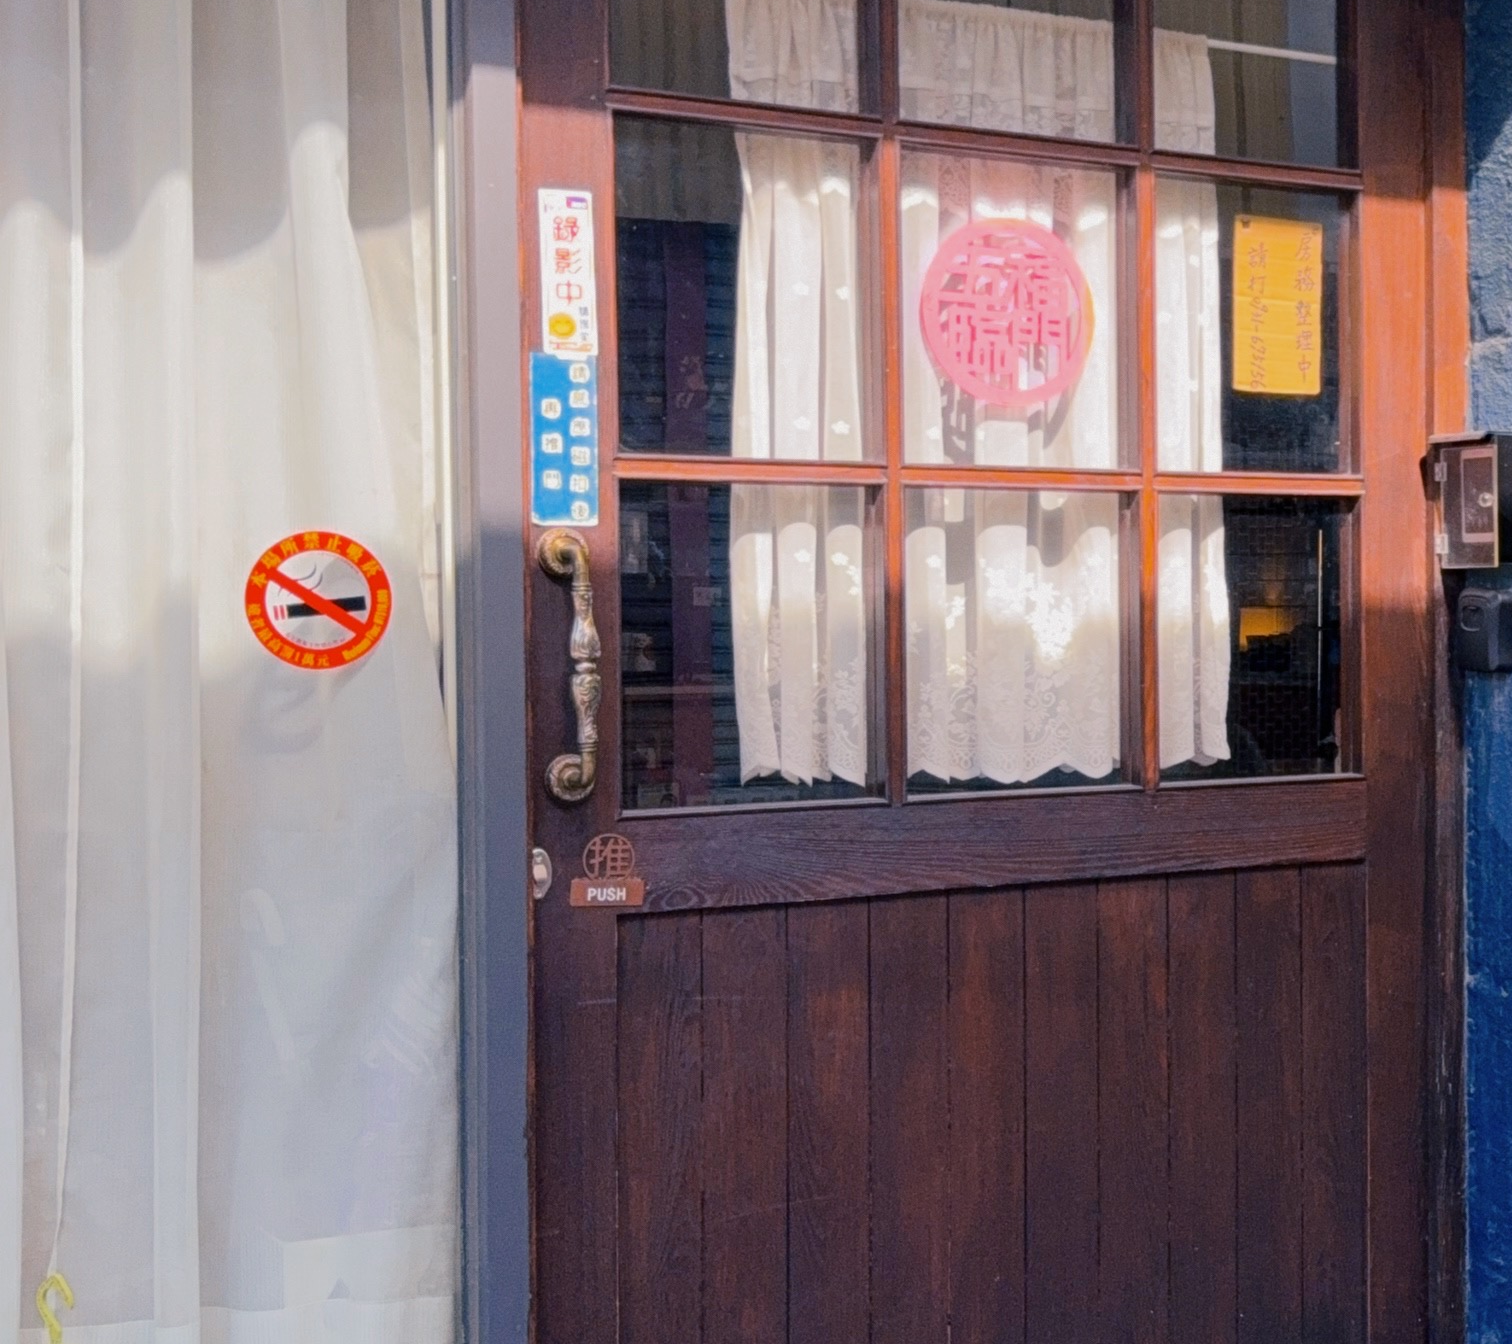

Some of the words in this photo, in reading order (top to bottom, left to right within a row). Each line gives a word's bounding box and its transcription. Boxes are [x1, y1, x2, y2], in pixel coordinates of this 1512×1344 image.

[552, 215, 583, 306] 錄影中
[588, 836, 631, 880] 推
[587, 887, 626, 902] PUSH
